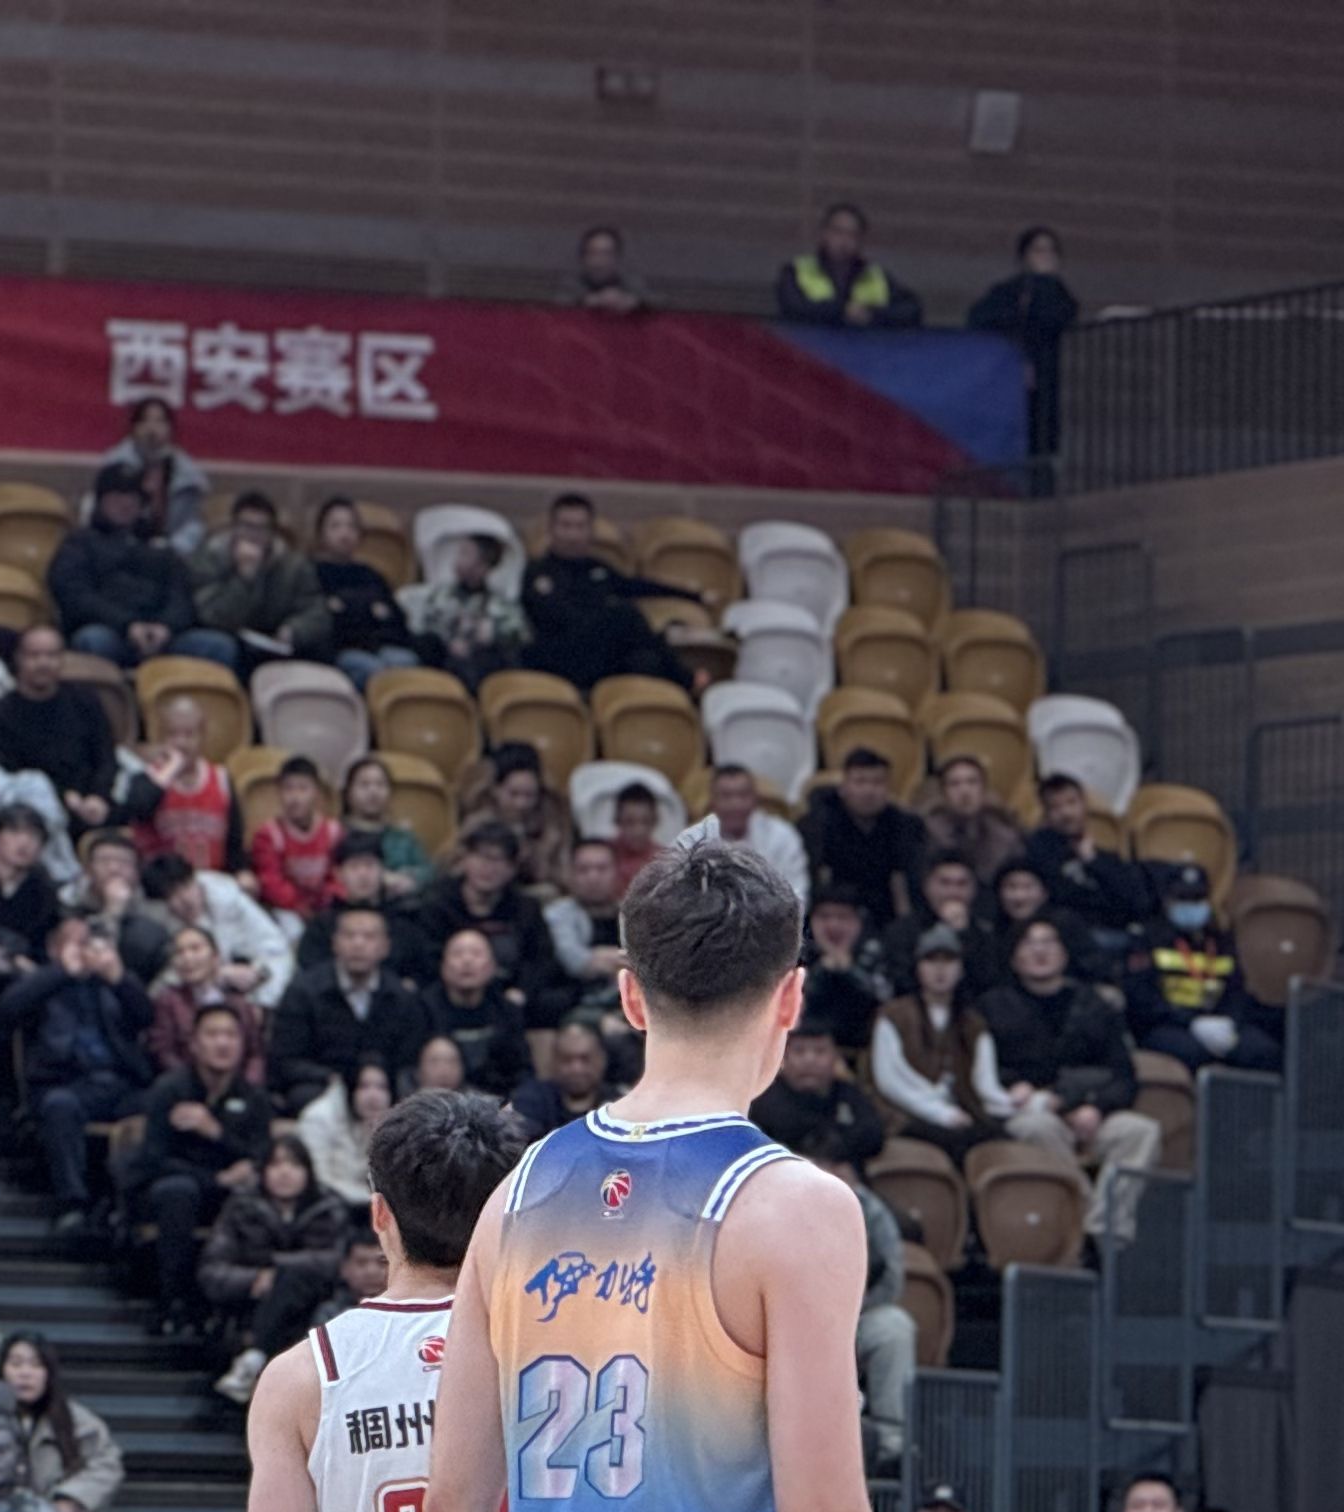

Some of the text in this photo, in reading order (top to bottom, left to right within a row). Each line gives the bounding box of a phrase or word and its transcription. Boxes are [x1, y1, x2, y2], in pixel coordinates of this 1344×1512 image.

[106, 318, 437, 421] 西安赛区
[517, 1354, 649, 1500] 23
